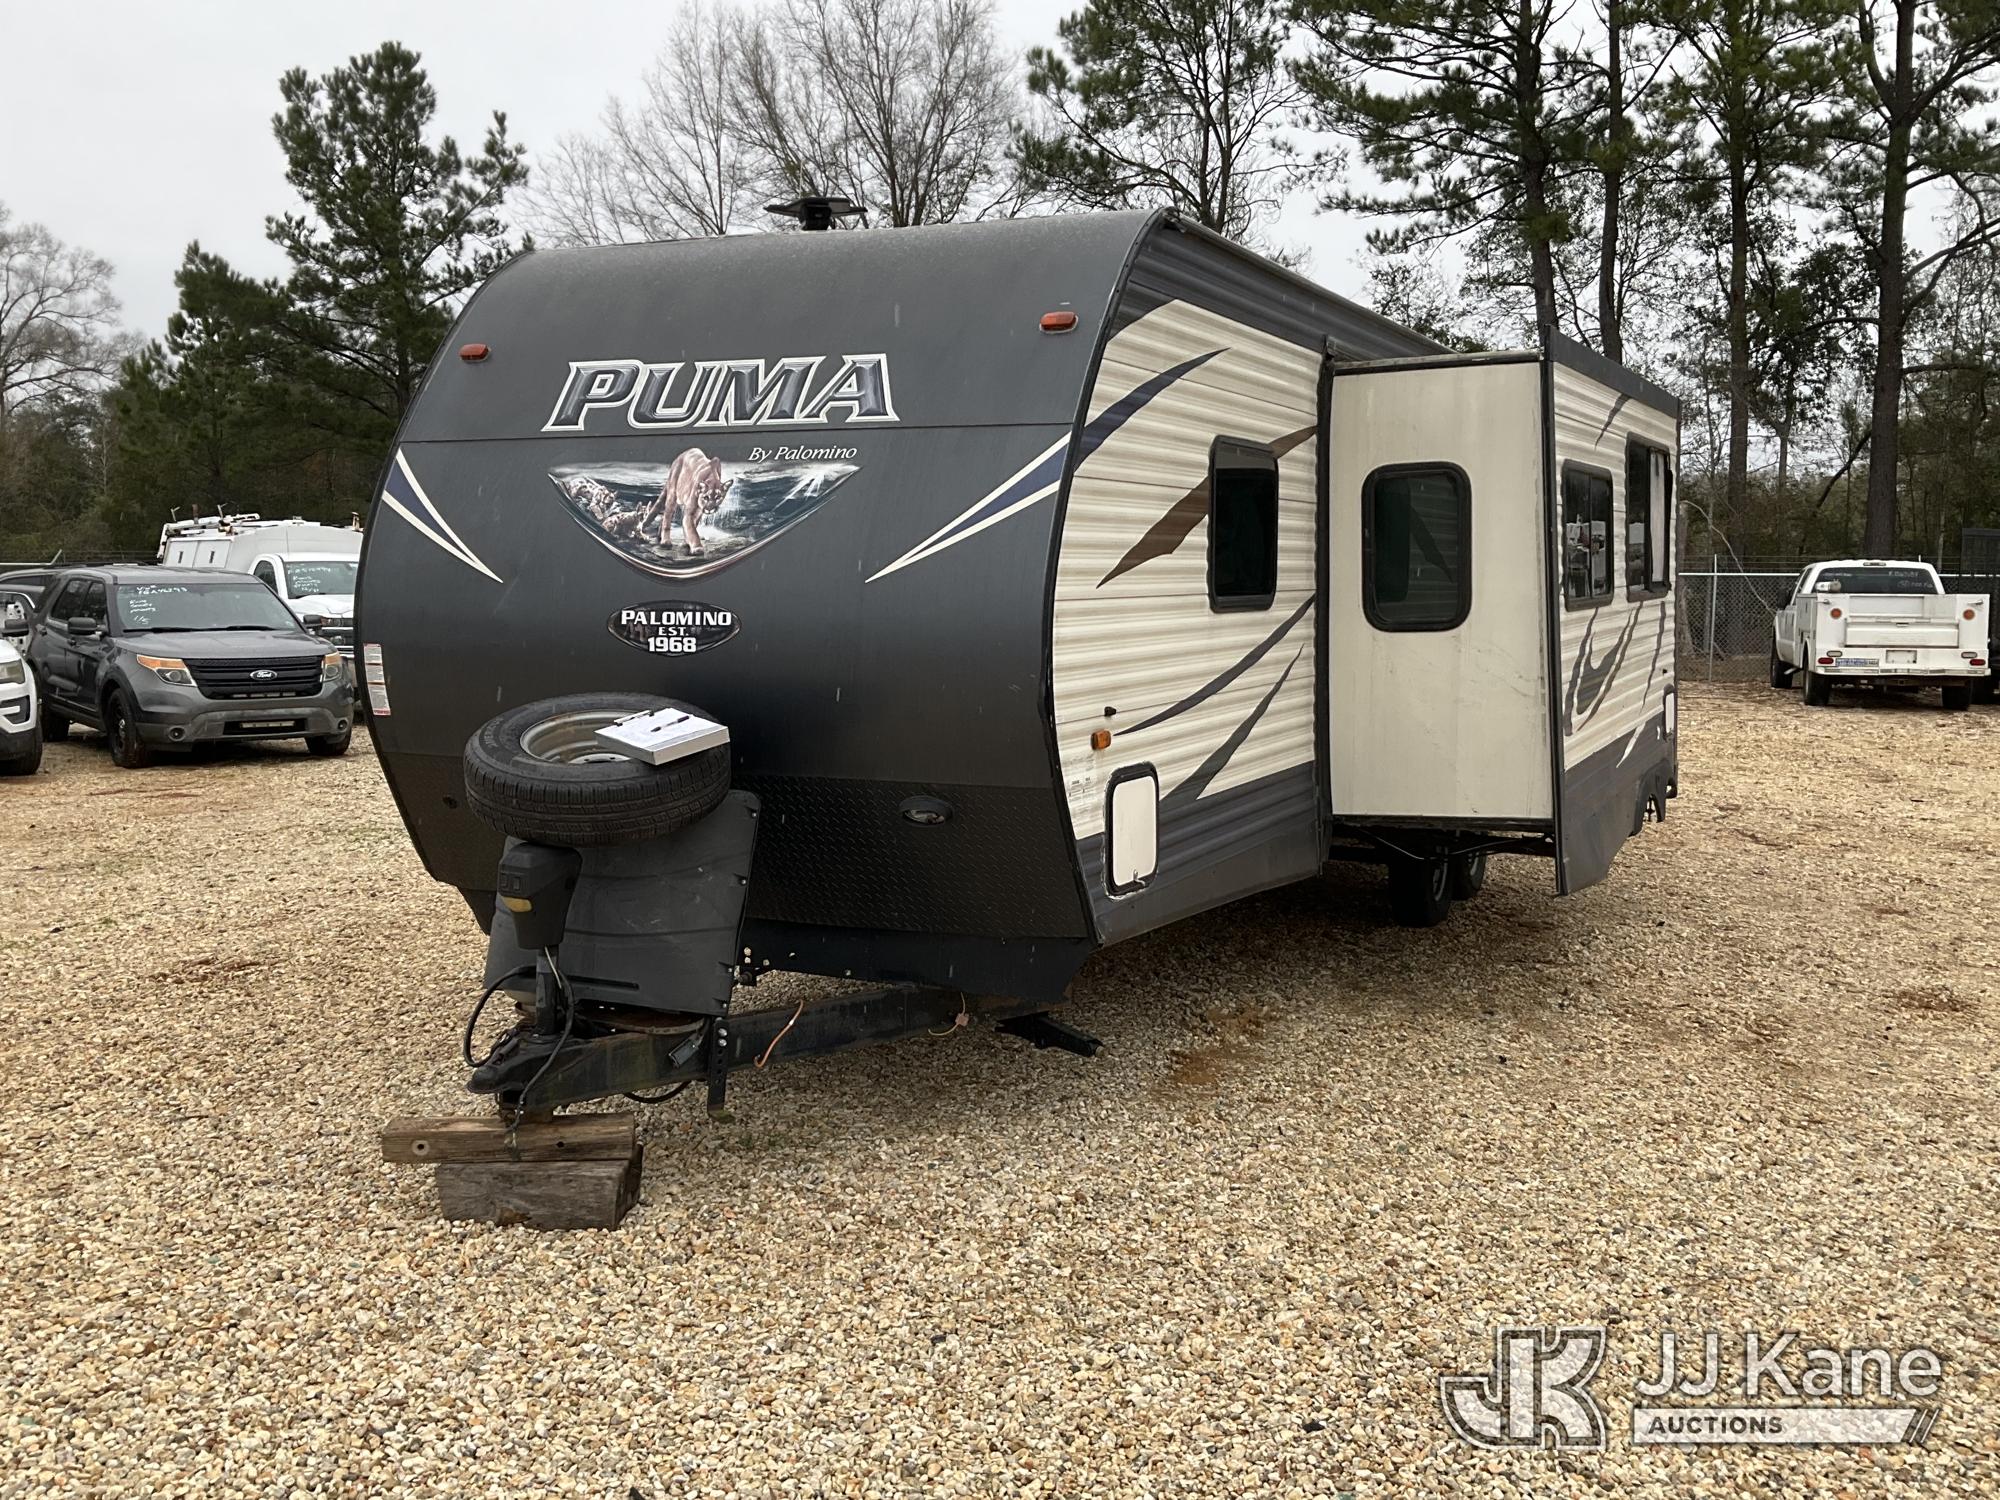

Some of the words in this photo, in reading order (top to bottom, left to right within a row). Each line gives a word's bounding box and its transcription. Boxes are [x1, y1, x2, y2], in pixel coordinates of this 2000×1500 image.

[540, 353, 901, 432] PUMA
[748, 447, 774, 463] By
[775, 445, 858, 461] Palomino
[621, 610, 732, 626] PALOMINO
[658, 626, 689, 636] EST.
[648, 637, 697, 652] 1968
